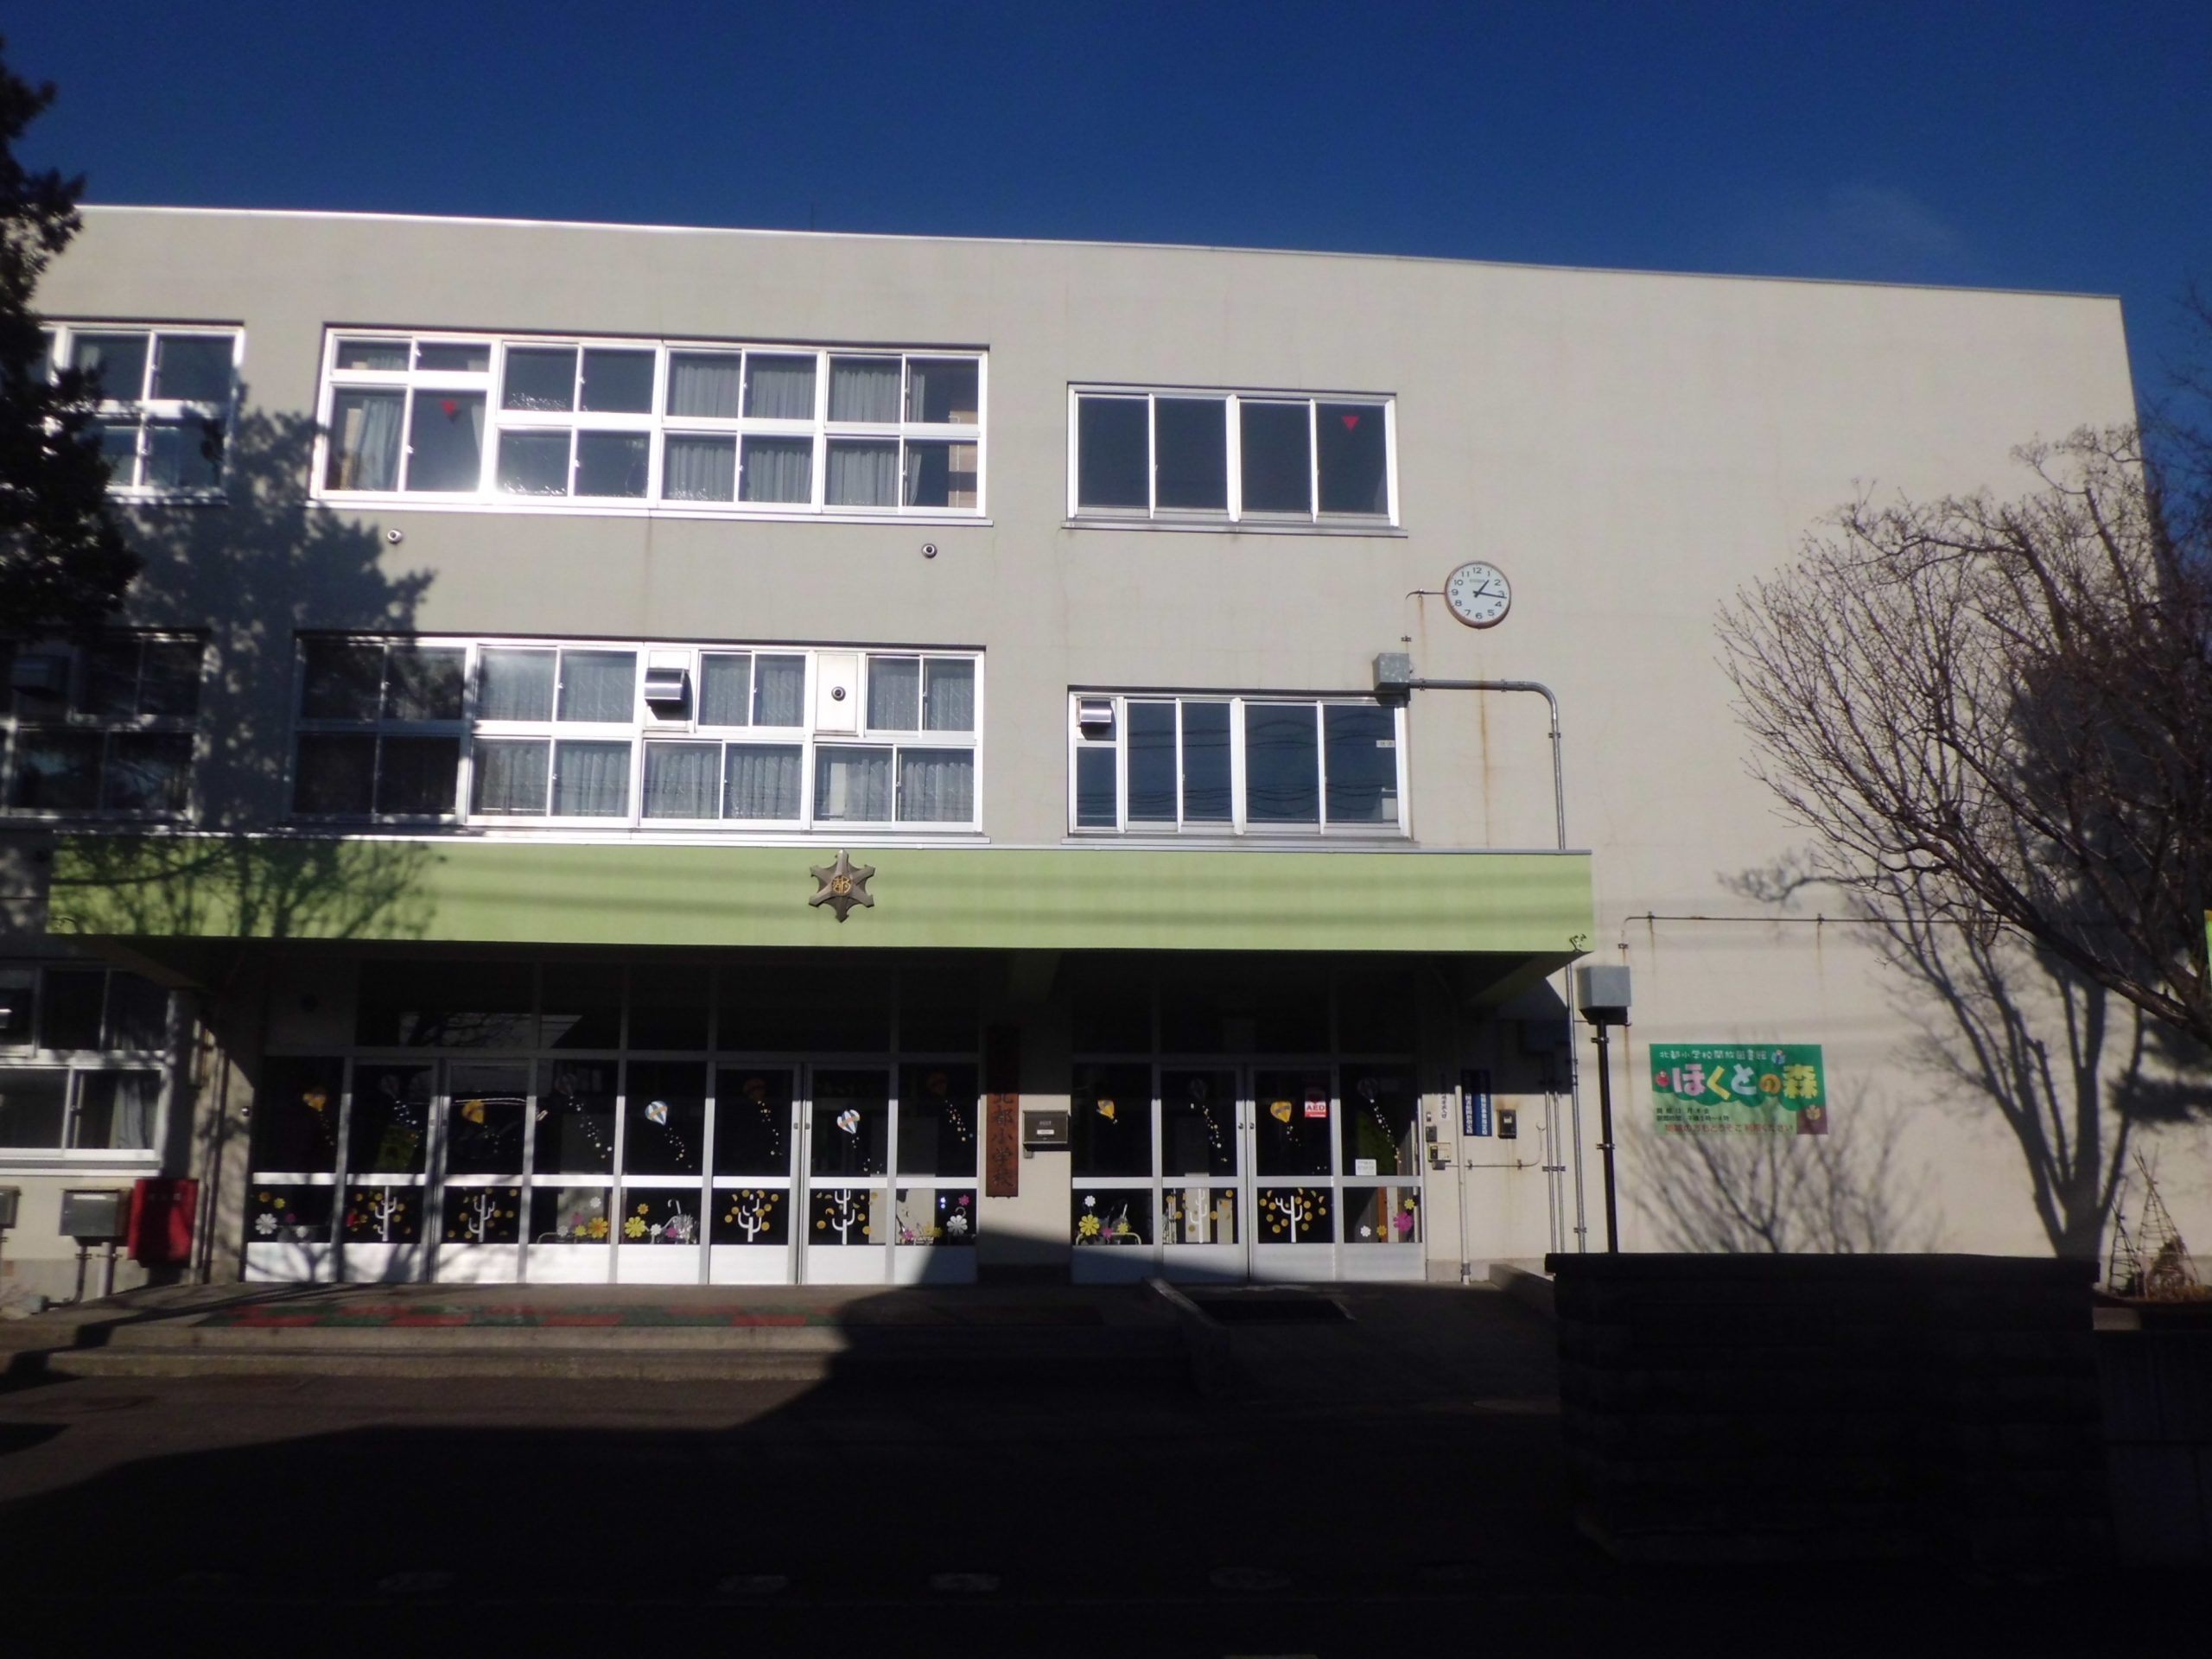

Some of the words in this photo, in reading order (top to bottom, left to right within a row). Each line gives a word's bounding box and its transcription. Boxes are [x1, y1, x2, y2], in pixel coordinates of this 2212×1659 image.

[1672, 1063, 1818, 1101] ほくとの森
